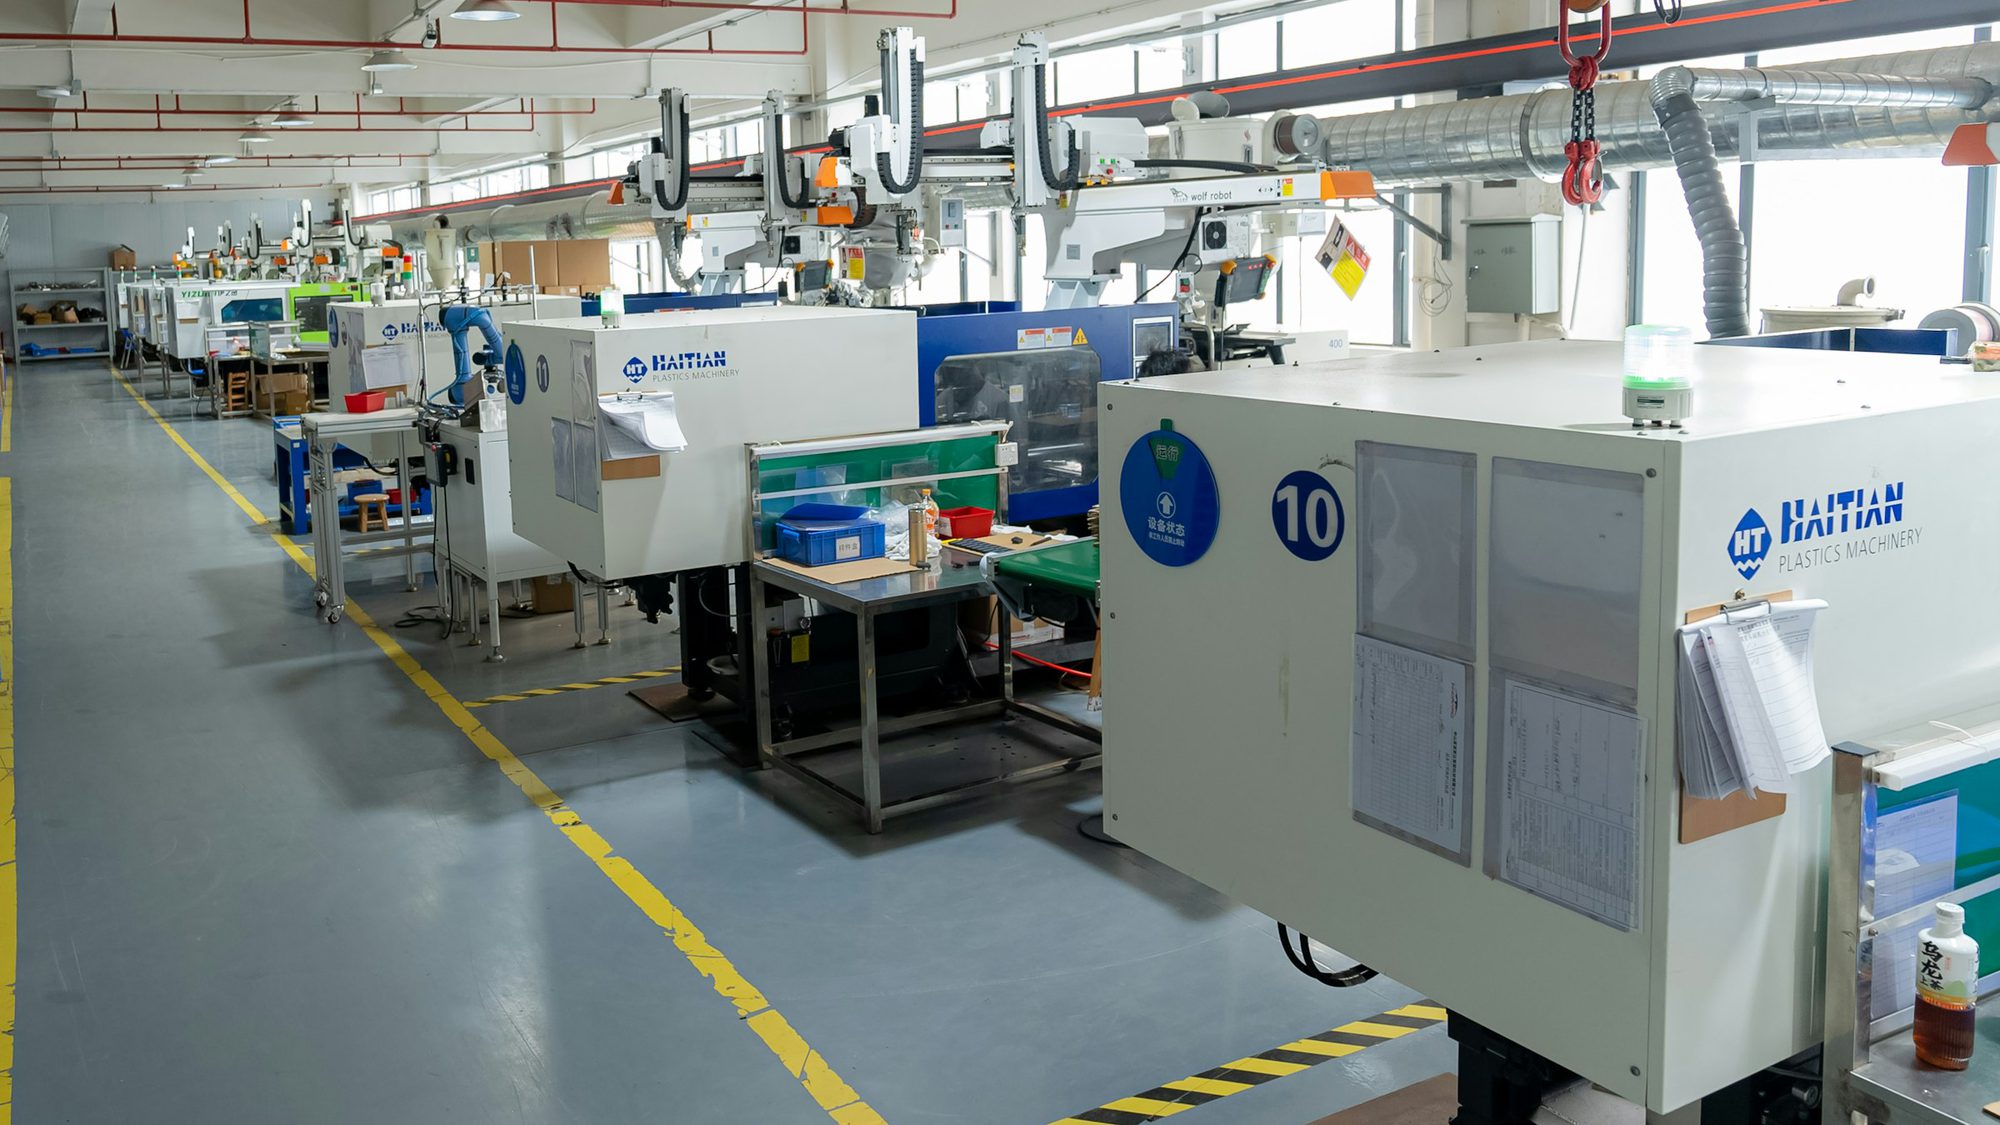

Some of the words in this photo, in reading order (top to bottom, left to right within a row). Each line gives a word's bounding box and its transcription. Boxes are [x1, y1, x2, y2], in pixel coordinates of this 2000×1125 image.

[1191, 191, 1208, 201] wolf
[1210, 191, 1232, 200] robot
[1329, 339, 1343, 348] 400
[626, 363, 644, 375] HT
[652, 351, 726, 371] HAITIAN
[537, 361, 547, 387] 11
[652, 371, 690, 382] PLASTICS
[692, 368, 740, 381] MACHINERY
[1156, 444, 1179, 462] 运行
[1276, 484, 1339, 548] 10
[1780, 482, 1904, 544] HAITIAN
[1147, 516, 1186, 537] 设备状态
[1734, 527, 1766, 557] HT
[1778, 543, 1841, 573] PLASTICS
[1846, 527, 1923, 560] MACHINERY
[1921, 940, 1944, 980] 乌龙
[1919, 974, 1944, 991] 上茶
